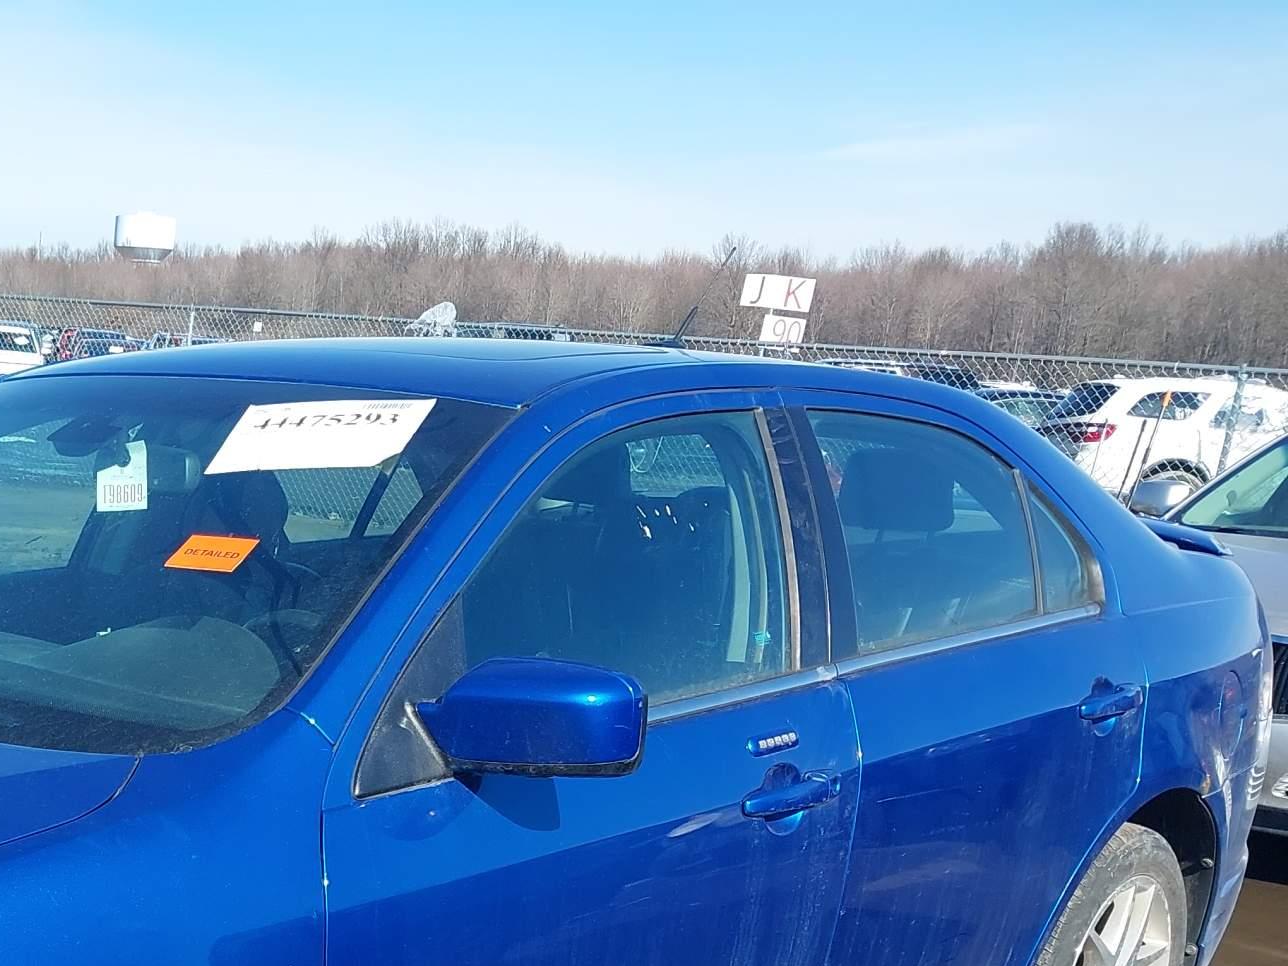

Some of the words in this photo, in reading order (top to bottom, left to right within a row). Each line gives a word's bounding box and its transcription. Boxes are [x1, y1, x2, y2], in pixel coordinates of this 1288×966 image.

[749, 276, 766, 304] J
[783, 278, 807, 309] K
[254, 412, 401, 430] 44475293
[184, 548, 240, 559] DETAILED
